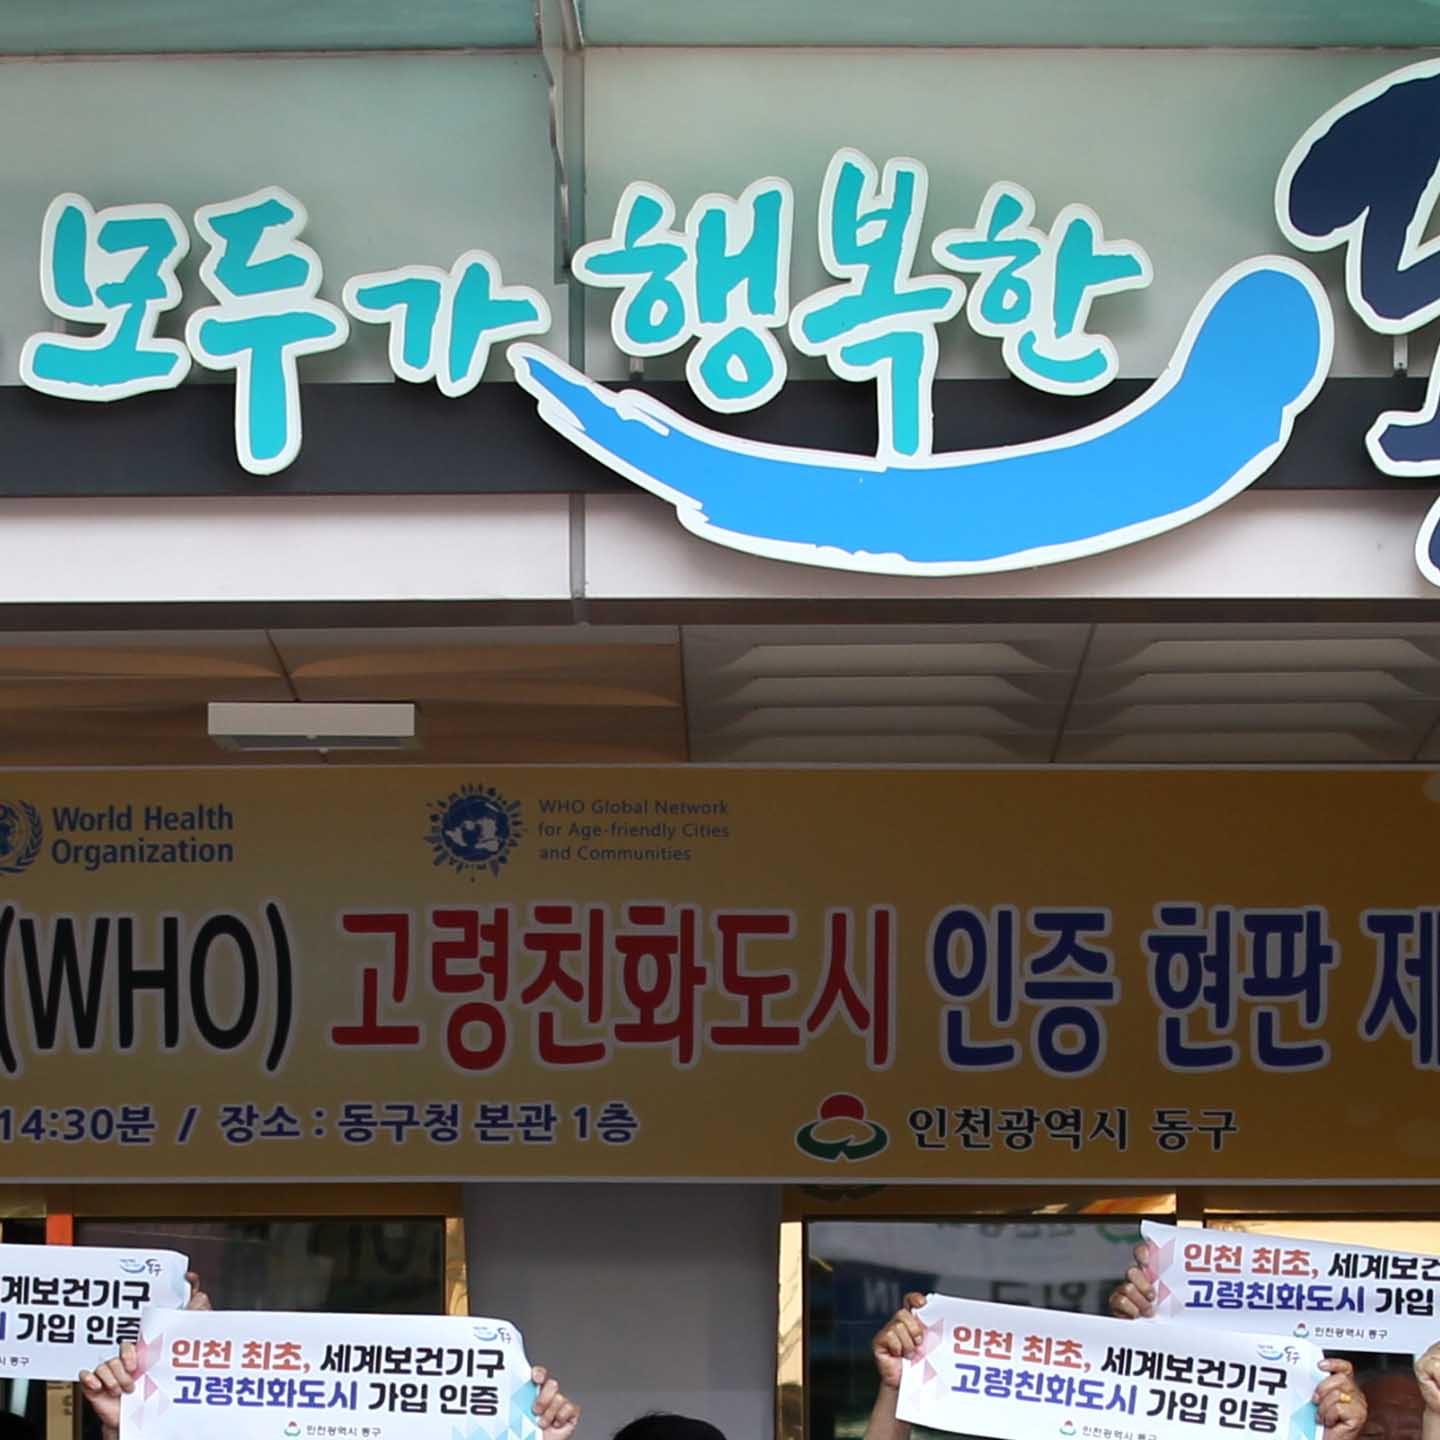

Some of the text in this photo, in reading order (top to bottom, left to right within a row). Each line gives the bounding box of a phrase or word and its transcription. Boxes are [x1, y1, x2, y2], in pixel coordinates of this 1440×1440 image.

[28, 197, 540, 462] 모두가
[585, 160, 1152, 456] 행복한
[51, 803, 235, 831] World Health
[539, 799, 729, 815] WHO Global Network
[538, 821, 730, 842] for Age-friendly Cities
[51, 836, 235, 871] Organization
[539, 845, 692, 862] and Communities
[330, 906, 891, 1070] 고령친화도시
[930, 905, 1109, 1070] 인증
[1145, 904, 1334, 1071] 현판
[337, 1103, 460, 1144] 동구청
[472, 1103, 559, 1144] 본관
[571, 1102, 639, 1144] 1층
[907, 1106, 1239, 1152] 인천광역시 동구
[172, 1340, 505, 1378] 인천 최초, 세계보건기구
[953, 1326, 1287, 1395] 인천 최초, 세계보건기구
[173, 1376, 498, 1416] 고령친화도시 가입 인증
[952, 1363, 1279, 1433] 고령친화도시 가입 인증
